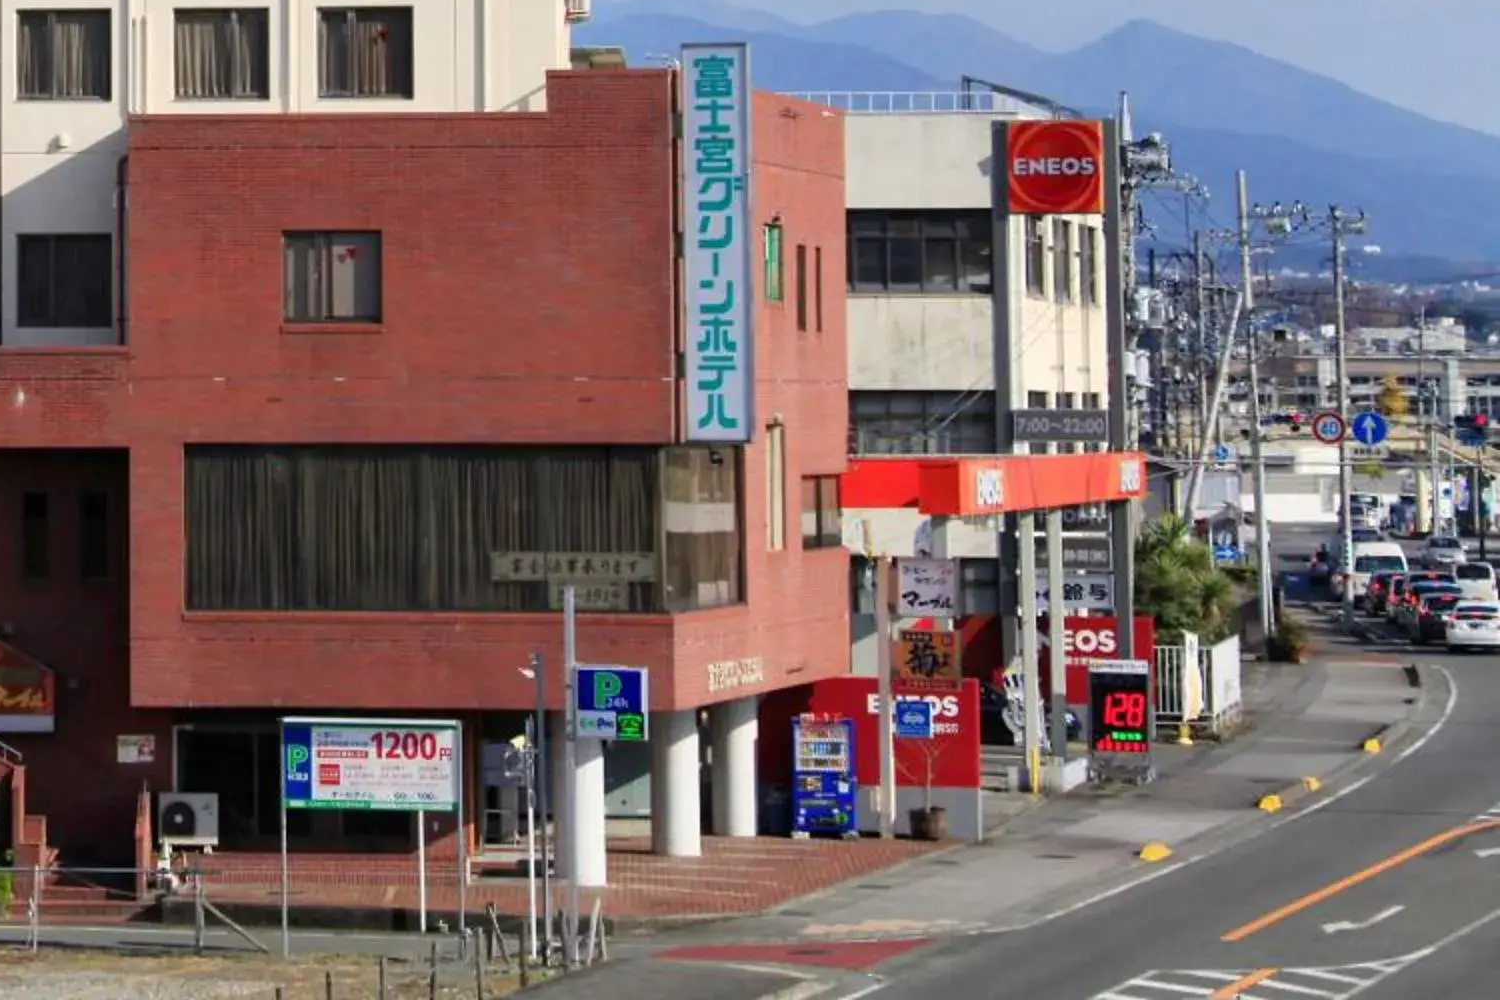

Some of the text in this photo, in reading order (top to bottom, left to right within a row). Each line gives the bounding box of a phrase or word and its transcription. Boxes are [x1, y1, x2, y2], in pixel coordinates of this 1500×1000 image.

[1012, 156, 1096, 177] ENEOS
[692, 54, 744, 430] 富士宮グリーンホテル
[1103, 692, 1146, 729] 128
